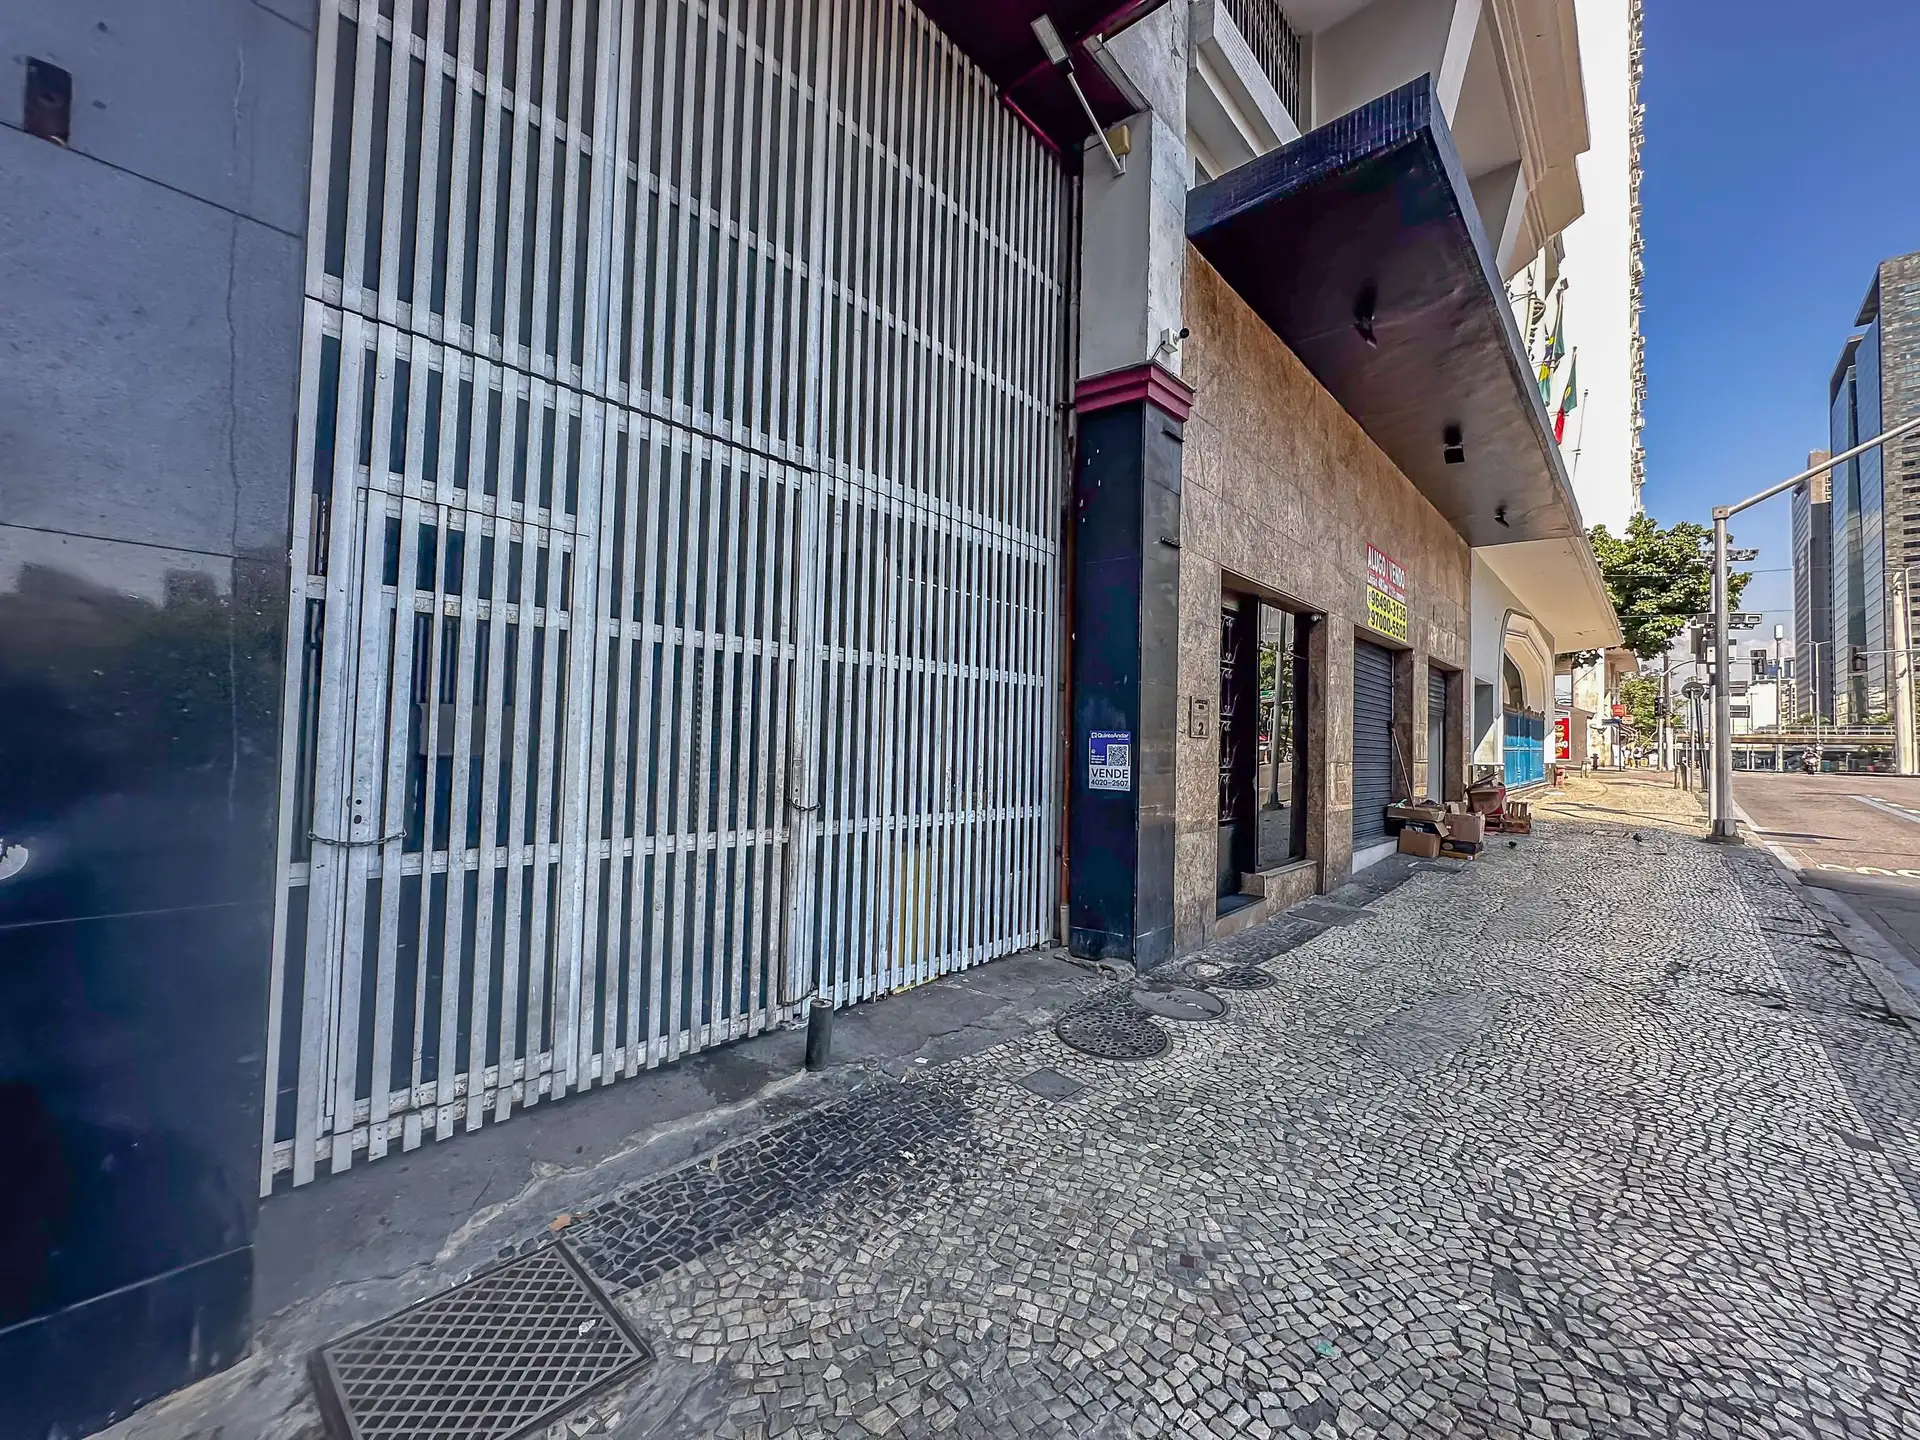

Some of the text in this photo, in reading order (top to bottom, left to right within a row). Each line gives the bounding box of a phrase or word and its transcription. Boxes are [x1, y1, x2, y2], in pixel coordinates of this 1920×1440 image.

[1367, 545, 1386, 577] ALUGO
[1388, 560, 1405, 590] VENDO
[1371, 589, 1406, 622] 96490-3139
[1198, 721, 1204, 736] 2
[1091, 768, 1129, 779] VENDE
[1090, 779, 1129, 787] 4020-2507
